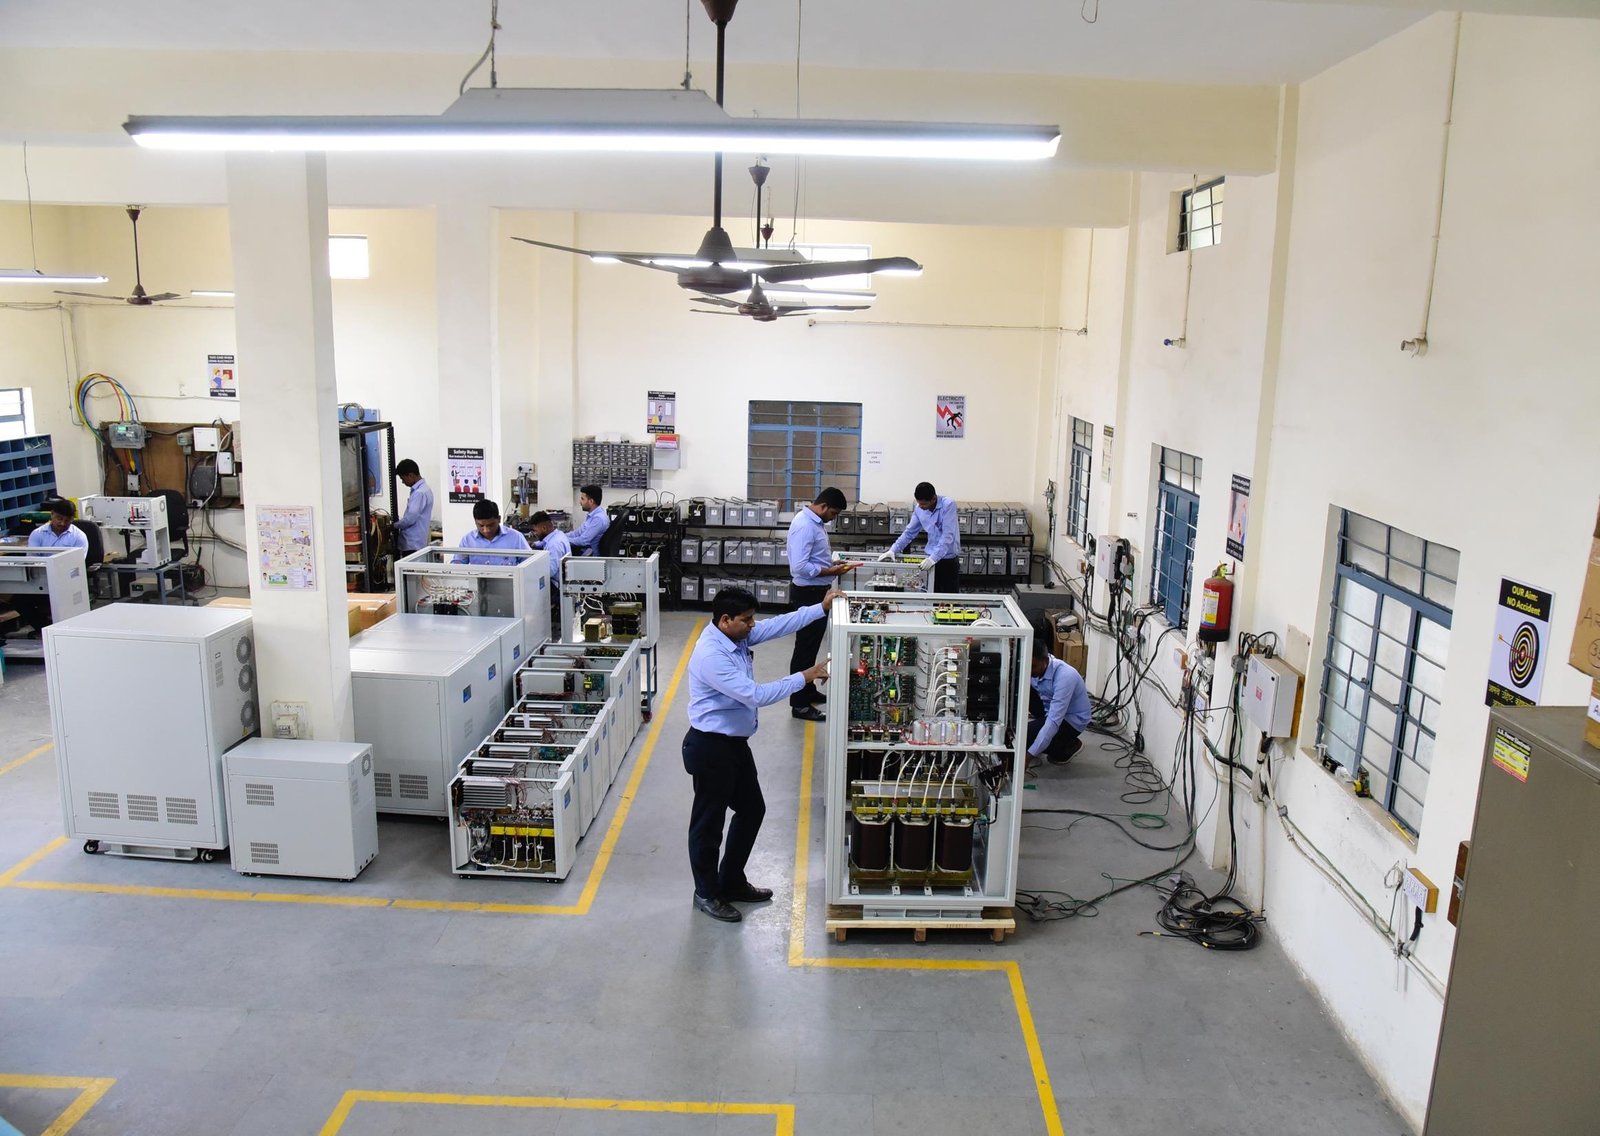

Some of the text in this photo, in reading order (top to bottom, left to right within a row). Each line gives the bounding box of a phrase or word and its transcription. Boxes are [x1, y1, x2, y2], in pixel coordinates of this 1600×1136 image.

[1511, 585, 1525, 597] OUR
[1506, 596, 1541, 616] NO Accident
